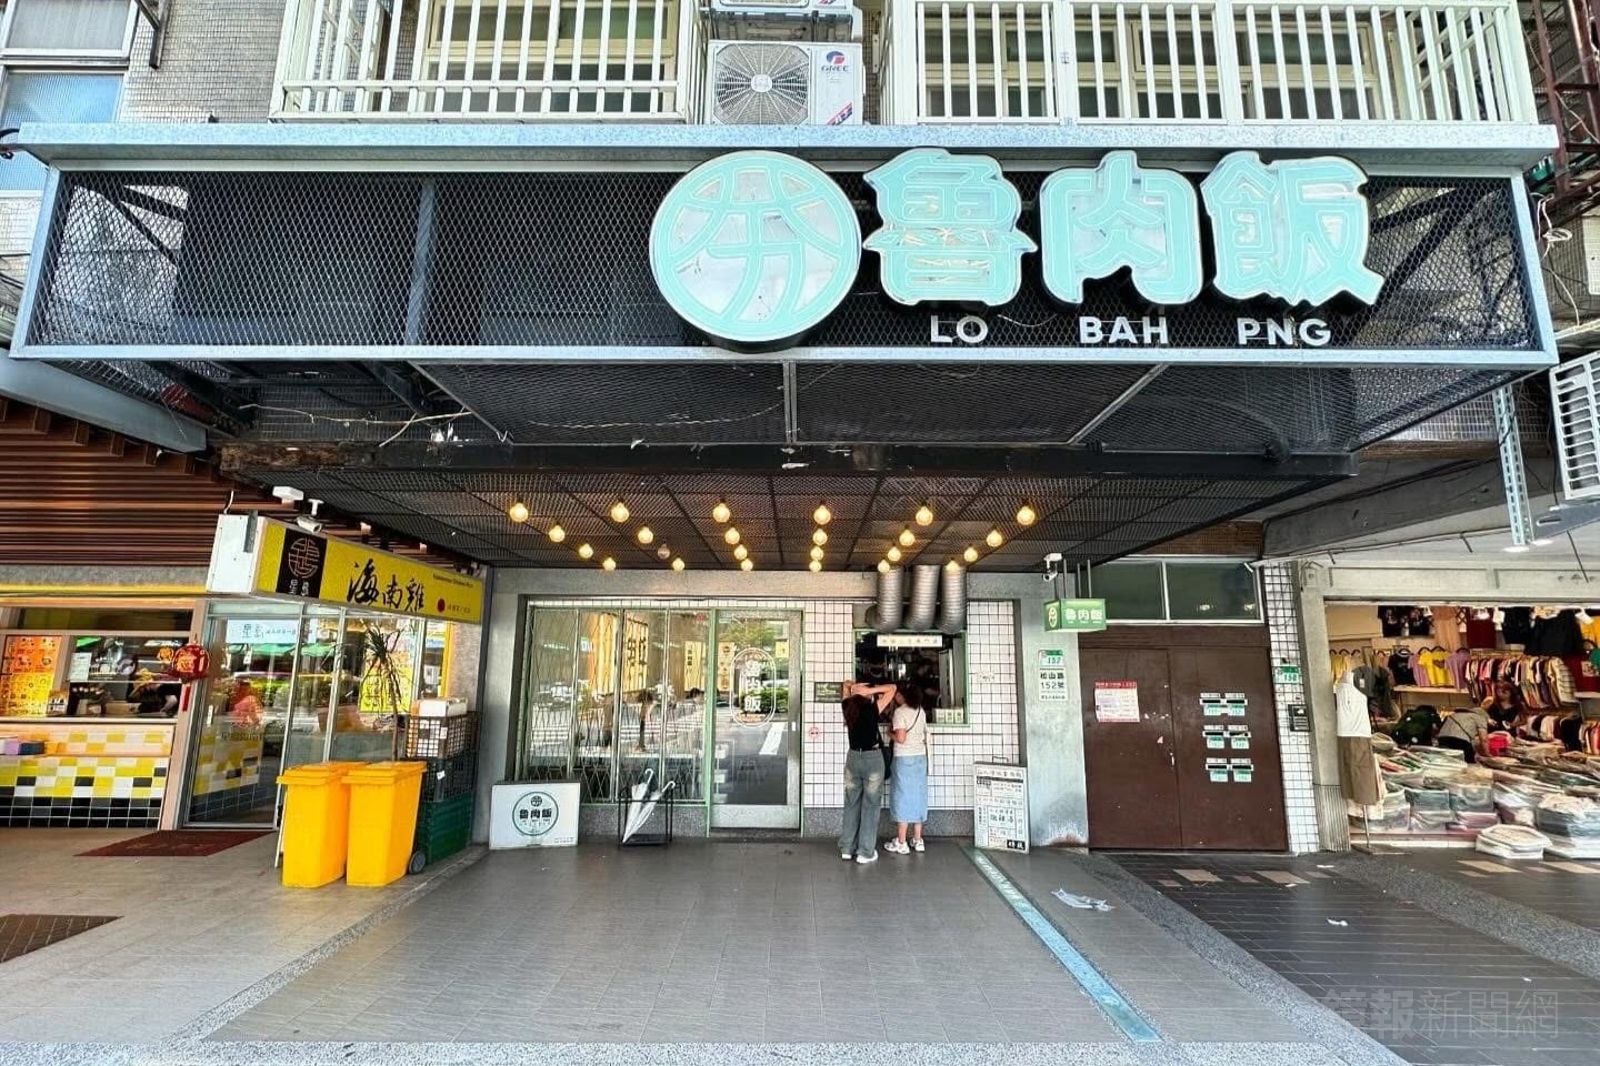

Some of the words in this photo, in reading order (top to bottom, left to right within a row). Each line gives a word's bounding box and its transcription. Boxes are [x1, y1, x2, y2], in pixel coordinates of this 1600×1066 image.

[862, 147, 1385, 306] 魯肉飯
[930, 314, 988, 343] LO
[1079, 315, 1168, 344] BAH
[1236, 317, 1331, 346] PNG
[346, 558, 425, 613] 海南雞
